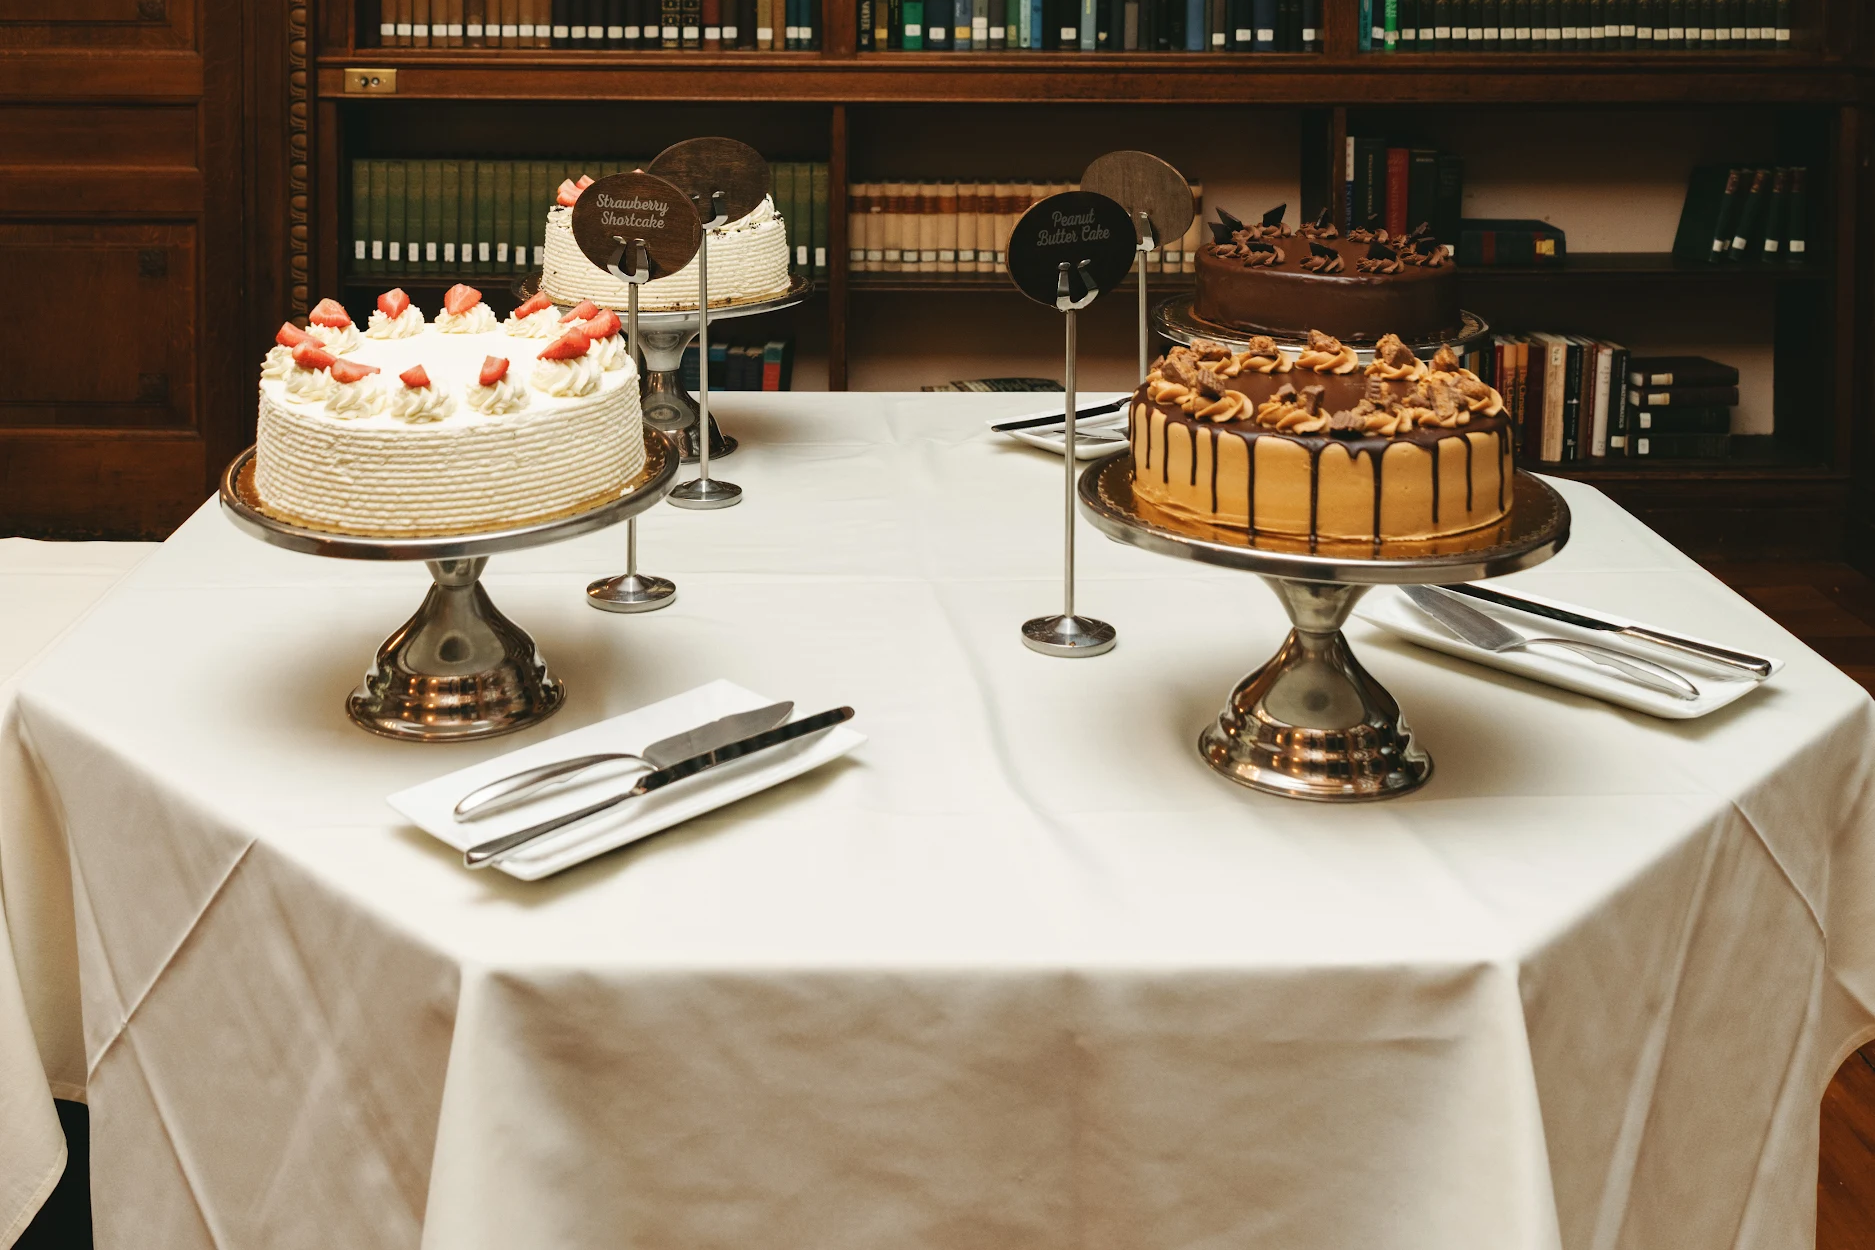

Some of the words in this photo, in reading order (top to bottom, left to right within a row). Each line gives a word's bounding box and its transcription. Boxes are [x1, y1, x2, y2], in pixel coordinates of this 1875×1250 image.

[596, 193, 670, 217] Strawberry
[601, 211, 665, 229] Shortcake
[1051, 208, 1095, 227] Peanut
[1036, 226, 1079, 246] Butter
[1081, 224, 1110, 242] Cake
[1518, 368, 1527, 383] The
[1517, 384, 1527, 424] Christians
